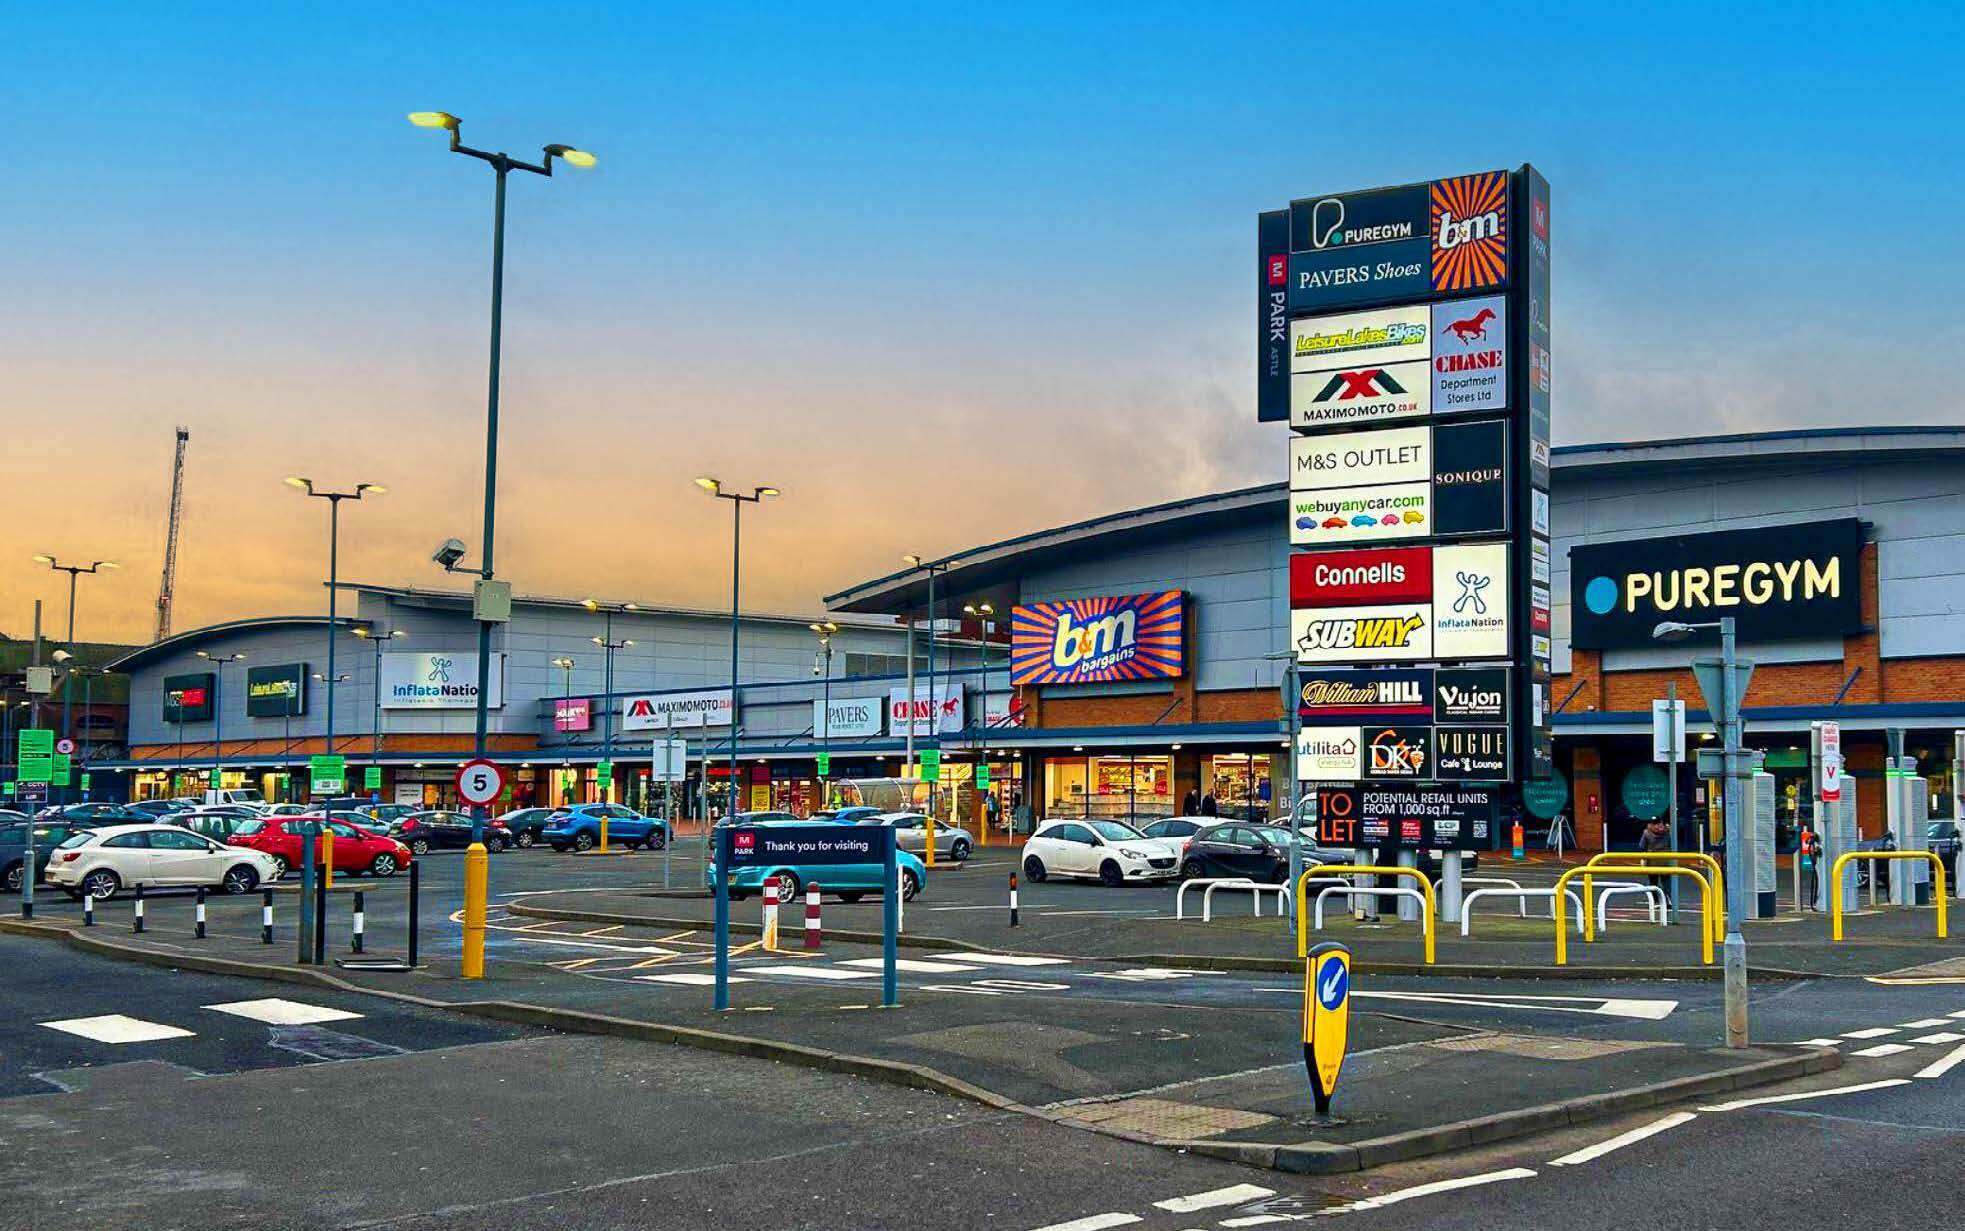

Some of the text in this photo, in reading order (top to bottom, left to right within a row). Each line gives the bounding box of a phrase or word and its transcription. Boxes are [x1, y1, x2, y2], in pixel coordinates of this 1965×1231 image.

[1345, 222, 1411, 244] PUREGYM
[1299, 261, 1422, 289] PAVERS Shoes
[1271, 262, 1285, 377] M PARK ASTLE
[1435, 350, 1502, 373] CHASE
[1440, 375, 1496, 390] Department
[1447, 390, 1491, 405] Stores Ltd
[1298, 445, 1421, 472] M&S OUTLET
[1436, 468, 1502, 484] SONIQUE
[1295, 494, 1424, 515] webuyanycar.com
[1315, 562, 1405, 586] Connells
[1626, 556, 1841, 613] PUREGYM
[1297, 612, 1425, 653] SUBWAY
[1437, 616, 1504, 629] InflataNation
[1081, 647, 1135, 673] bargains
[393, 684, 478, 696] InflataNatio
[1301, 679, 1423, 706] William HILL
[1439, 684, 1500, 709] Vujon
[829, 706, 869, 724] PAVERS
[1439, 733, 1504, 755] VOGUE
[1440, 757, 1504, 771] Cafe Lounge
[473, 774, 487, 792] 5
[1319, 793, 1352, 816] TO
[1363, 793, 1488, 804] POTENTIAL RETAIL UNITS
[1363, 804, 1395, 815] FROM
[1399, 804, 1425, 816] 1,000
[1426, 804, 1450, 817] sq.ft
[739, 836, 750, 844] M
[1321, 820, 1357, 842] LET
[765, 840, 869, 853] Thank you for visiting
